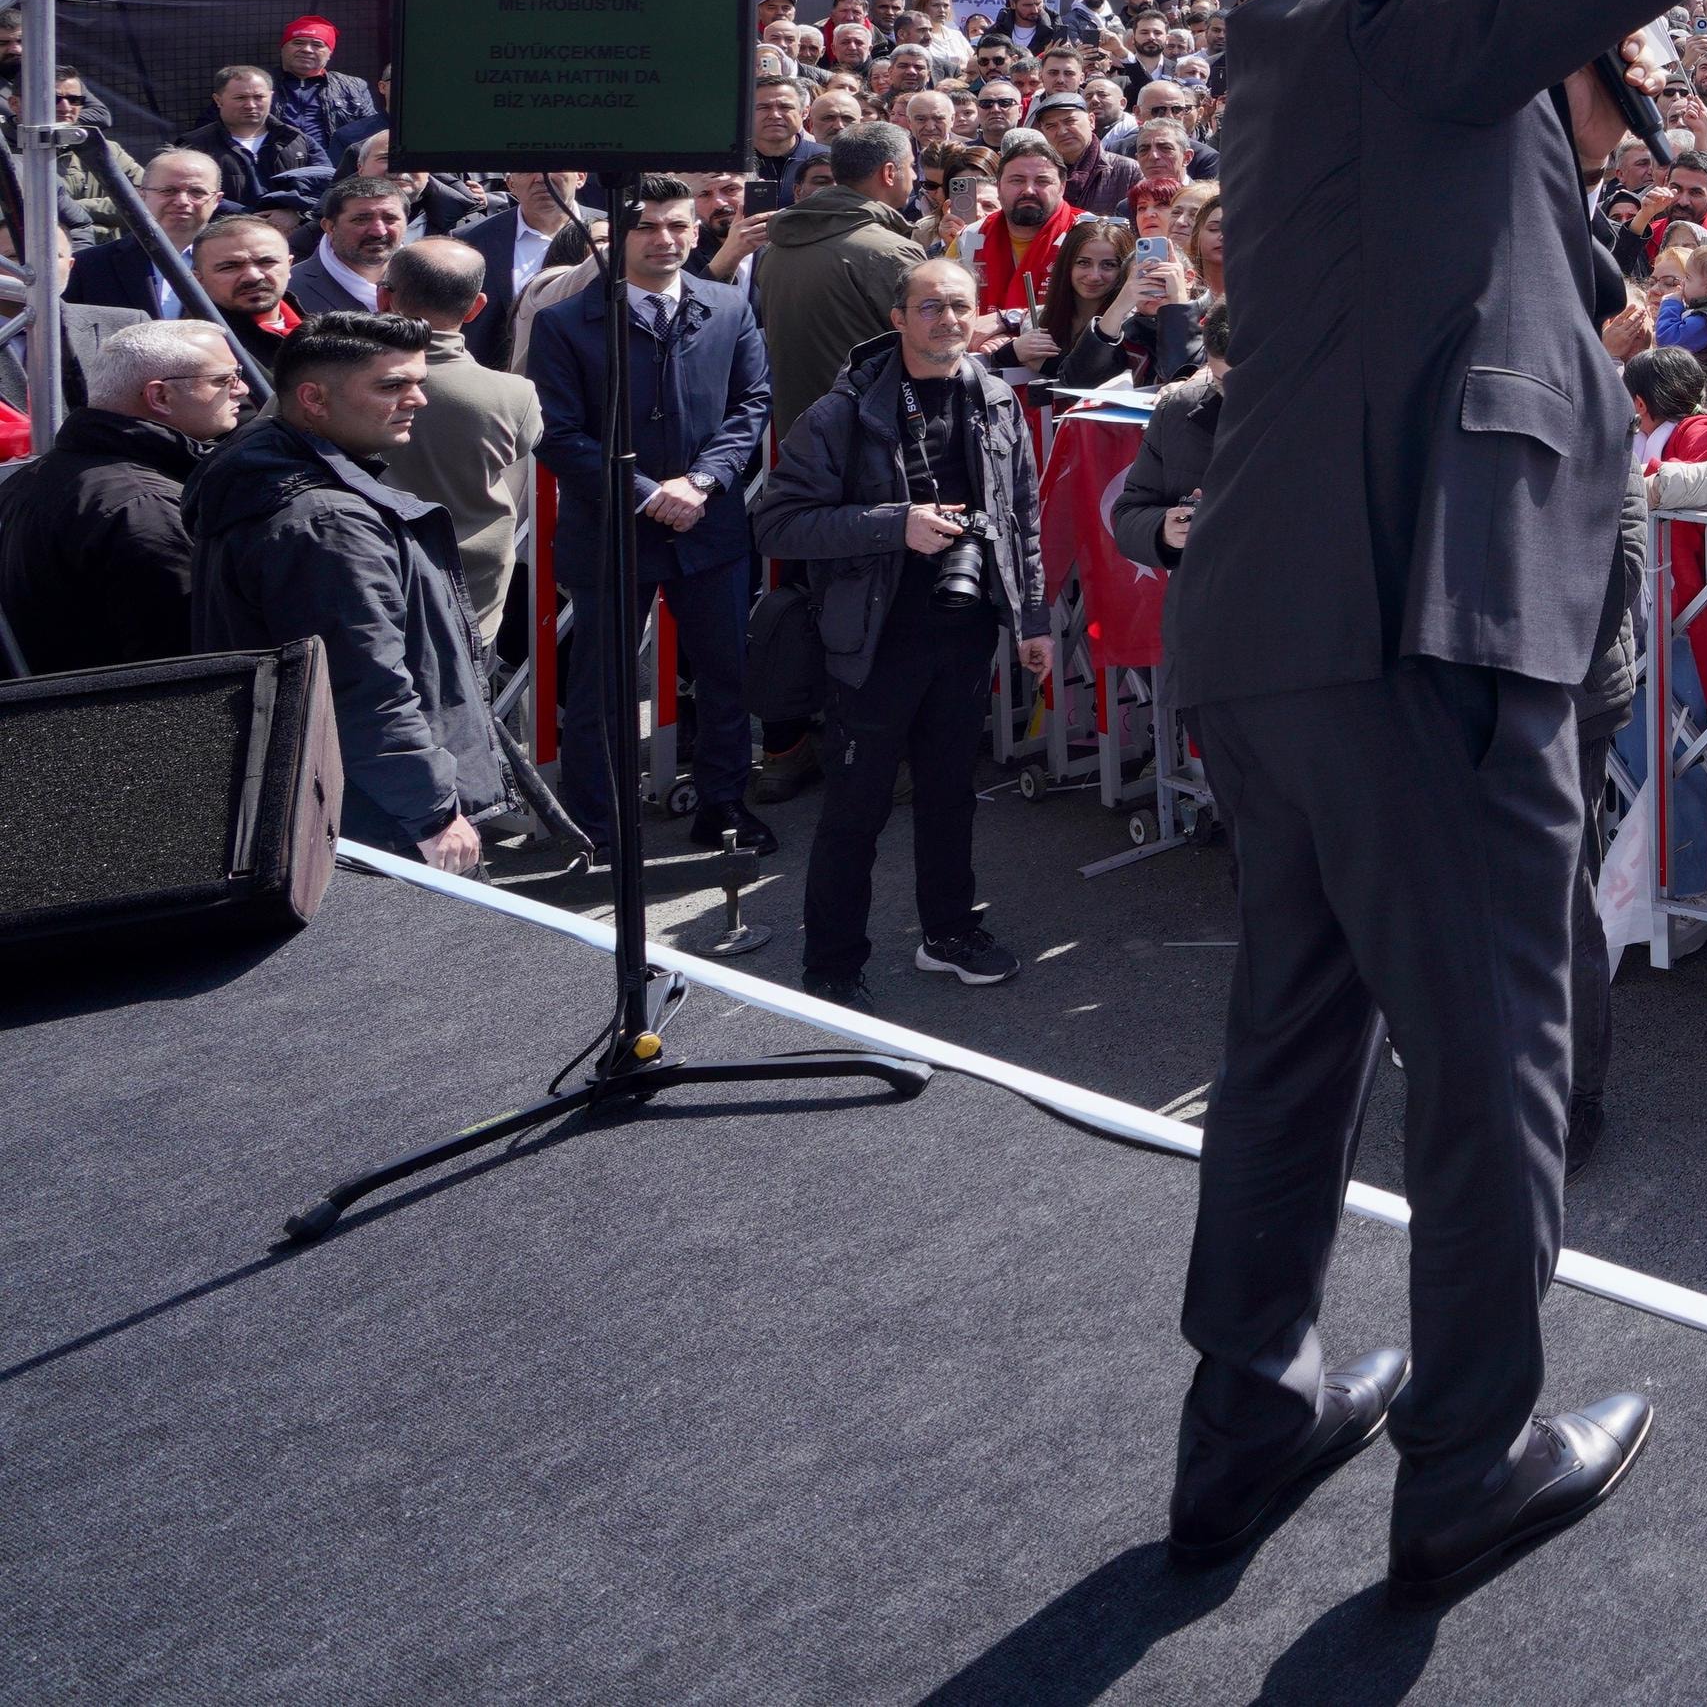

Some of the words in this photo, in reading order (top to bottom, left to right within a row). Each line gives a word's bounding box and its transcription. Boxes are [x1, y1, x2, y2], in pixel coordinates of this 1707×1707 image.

[490, 43, 651, 62] BÜYÜKÇEKMECE
[475, 70, 552, 84] UZATMA
[557, 70, 628, 84] HATTINI
[636, 70, 660, 84] DA
[494, 92, 524, 108] BİZ
[901, 381, 917, 413] SONY
